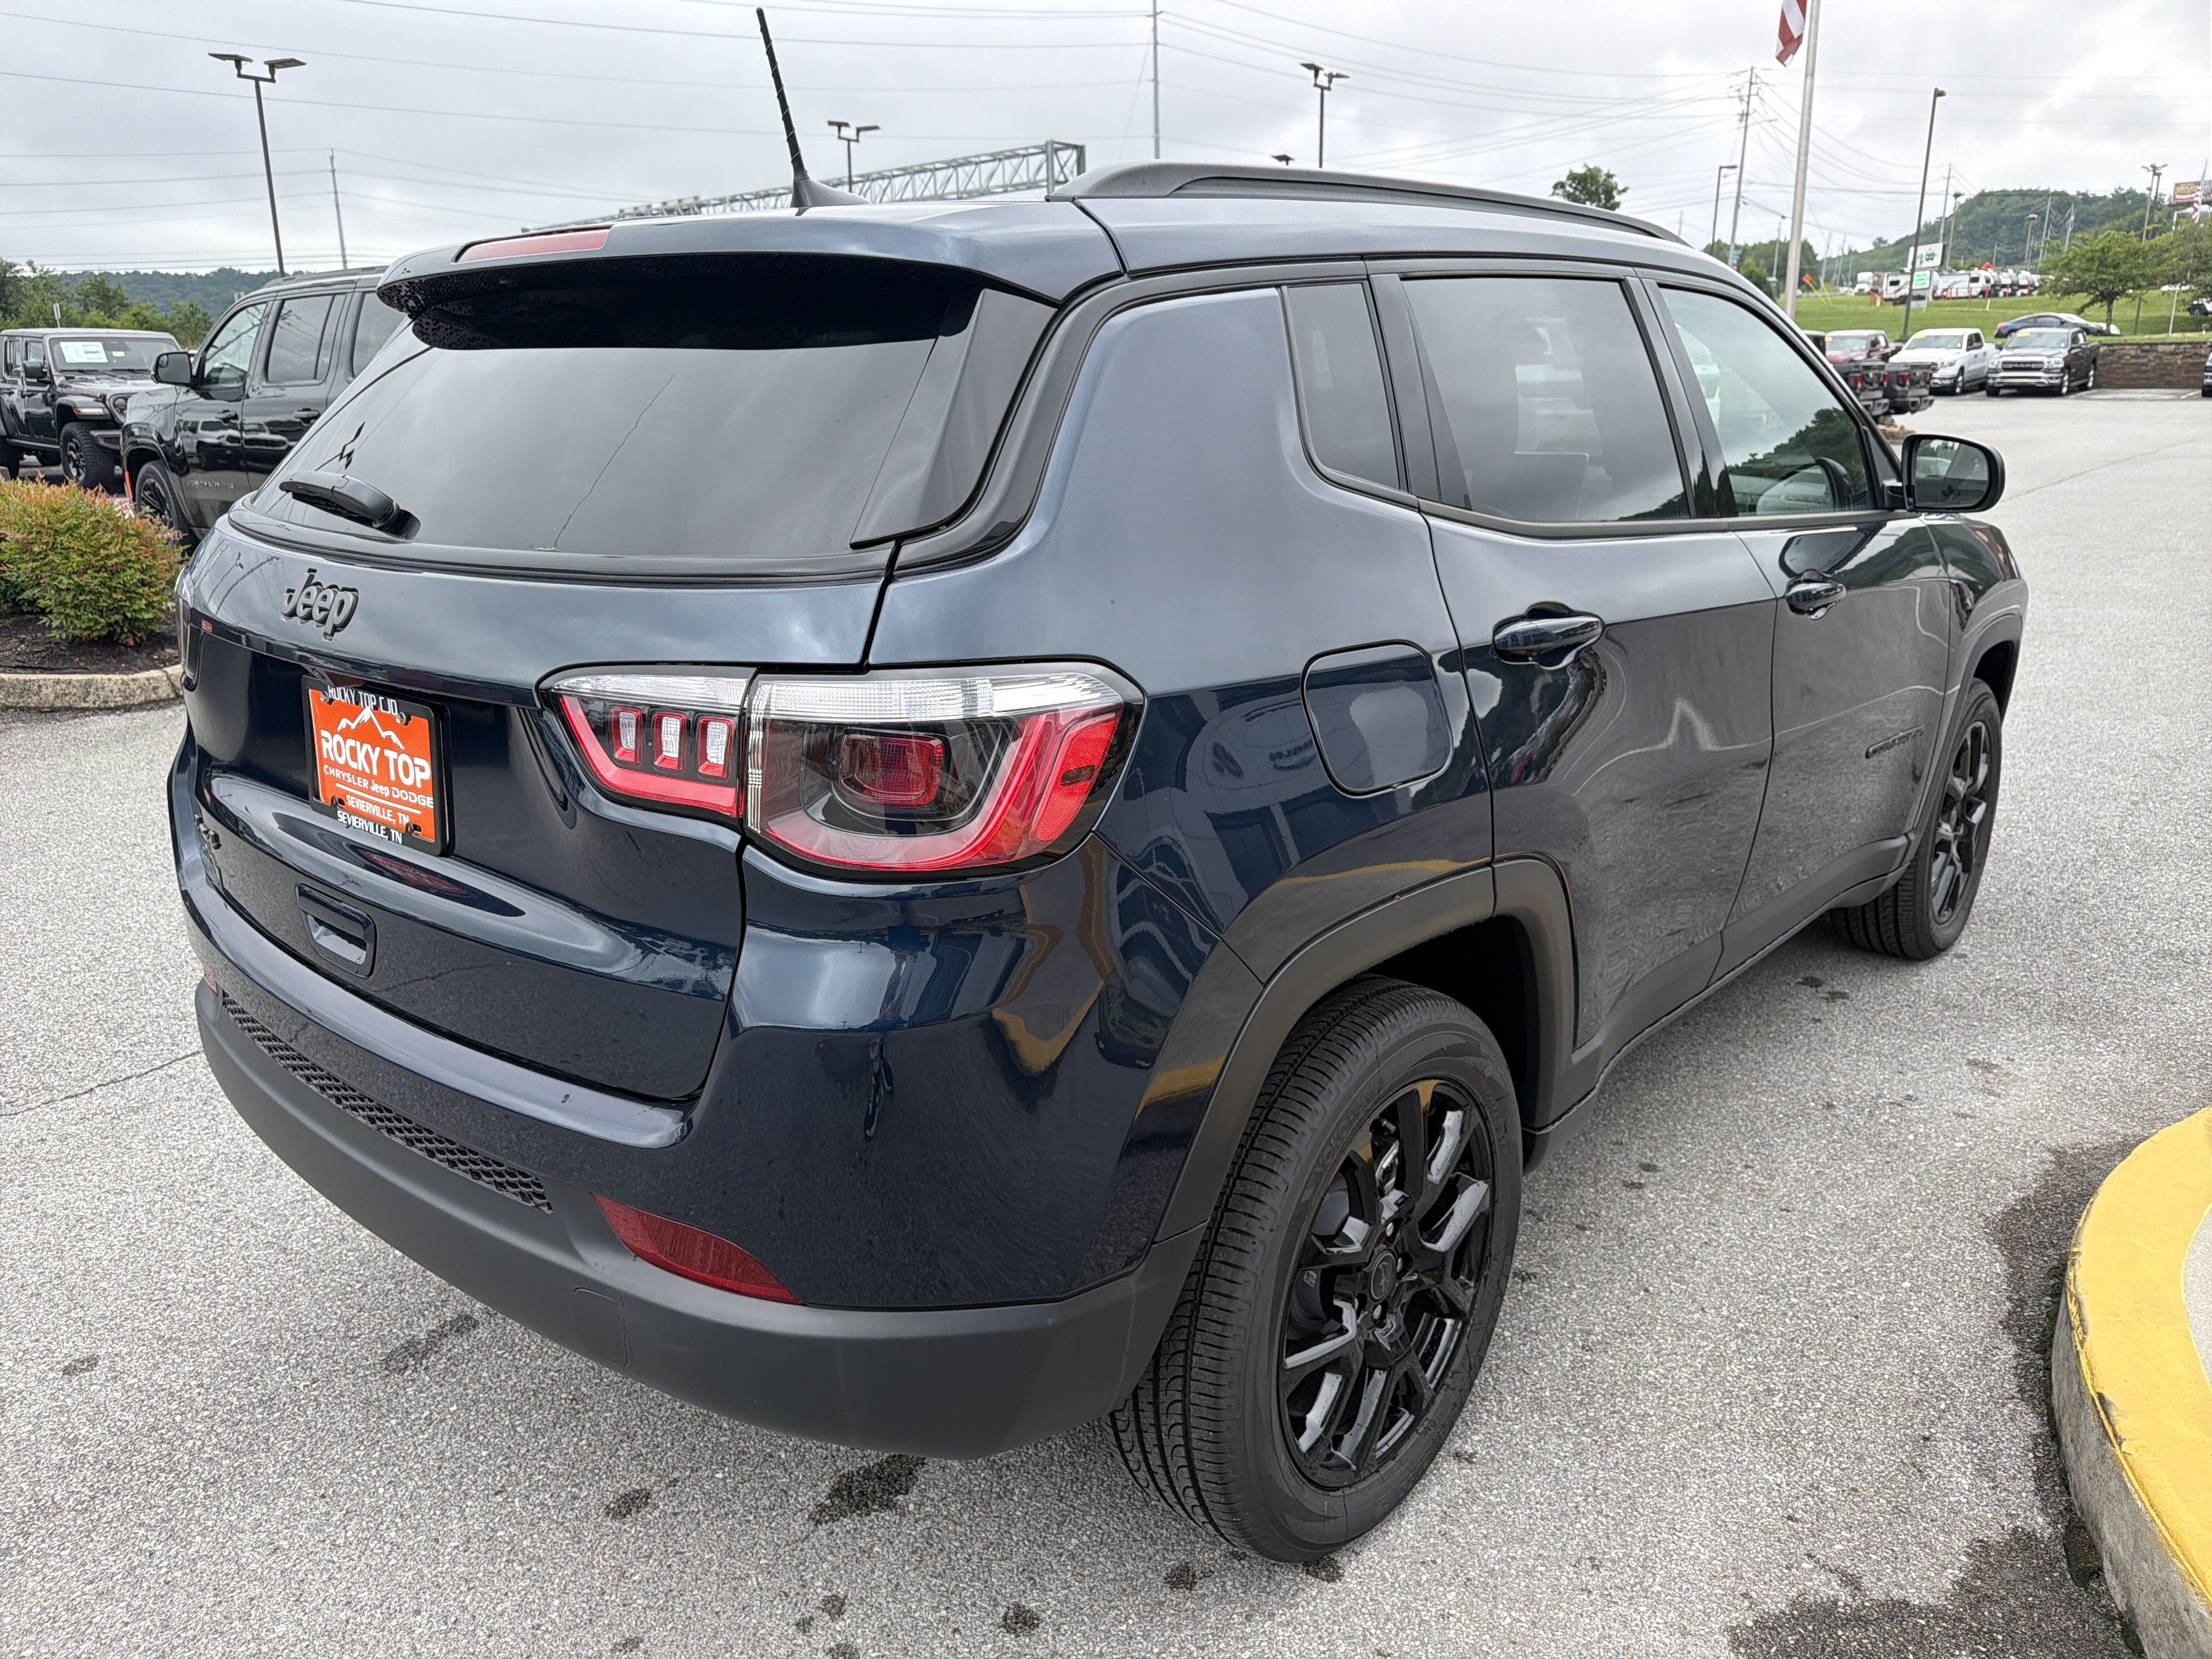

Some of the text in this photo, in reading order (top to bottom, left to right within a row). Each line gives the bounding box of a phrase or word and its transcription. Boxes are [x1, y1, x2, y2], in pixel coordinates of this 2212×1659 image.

[281, 568, 359, 641] Jeep
[327, 685, 398, 716] ROCKY TOP CJD
[320, 729, 431, 789] ROCKY TOP
[323, 764, 434, 809] CHRYSLER Jeep DODGE
[337, 810, 402, 844] SEVIERVILLE, TN
[346, 794, 410, 826] SEVIERVILLE, TN
